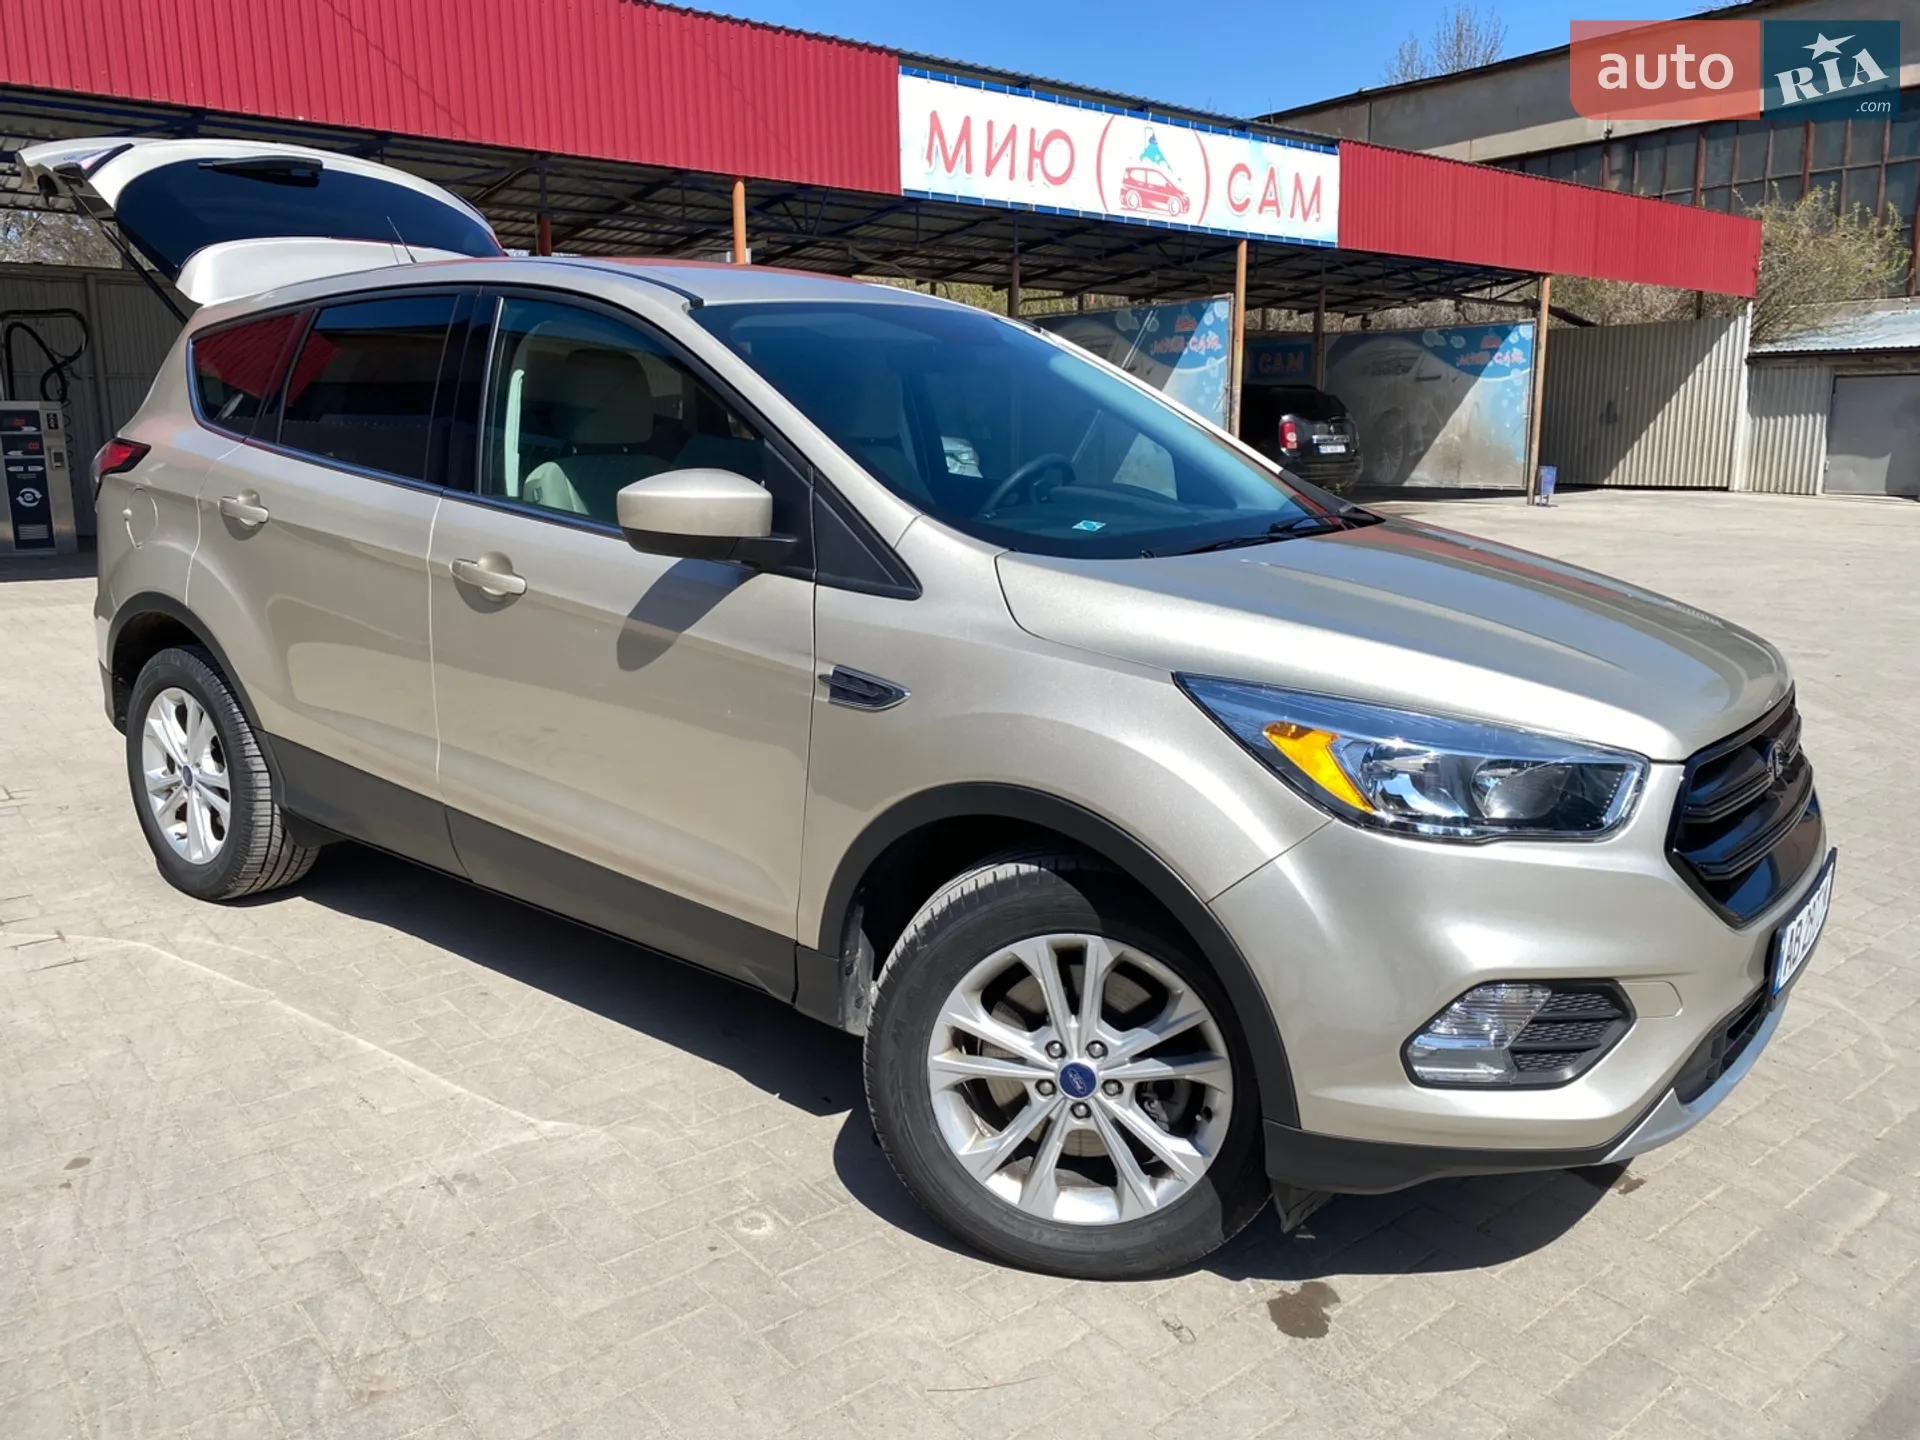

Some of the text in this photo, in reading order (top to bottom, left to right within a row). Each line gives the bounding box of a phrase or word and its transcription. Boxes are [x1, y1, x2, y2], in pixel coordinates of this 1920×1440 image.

[925, 110, 1323, 222] МИЮ САМ
[1258, 351, 1304, 374] САМ
